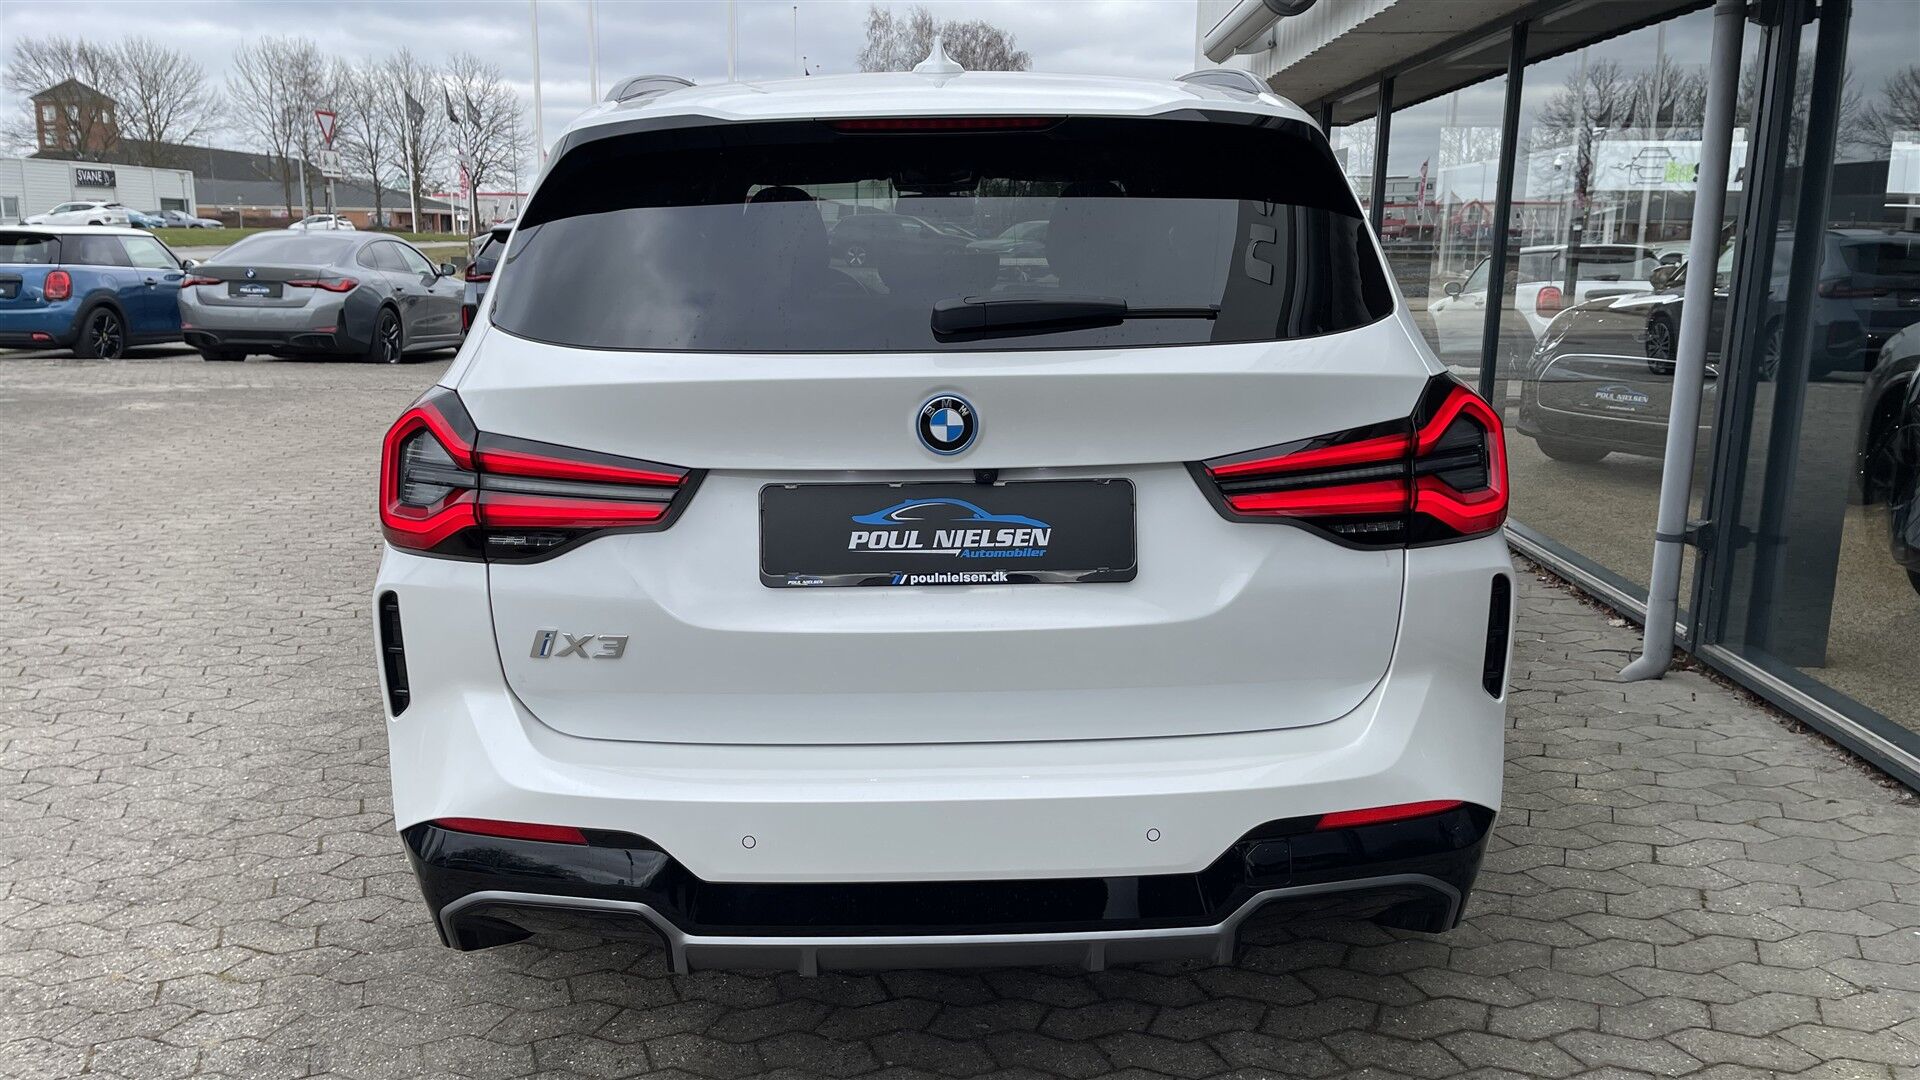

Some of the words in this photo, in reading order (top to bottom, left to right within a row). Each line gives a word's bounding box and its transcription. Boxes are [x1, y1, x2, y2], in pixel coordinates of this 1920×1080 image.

[77, 169, 103, 182] SVANE
[924, 399, 970, 417] BMW
[848, 530, 923, 549] POUL
[933, 528, 1051, 548] NIELSEN
[960, 548, 1047, 558] Automobiler
[910, 571, 1008, 585] poulnielsen.dk
